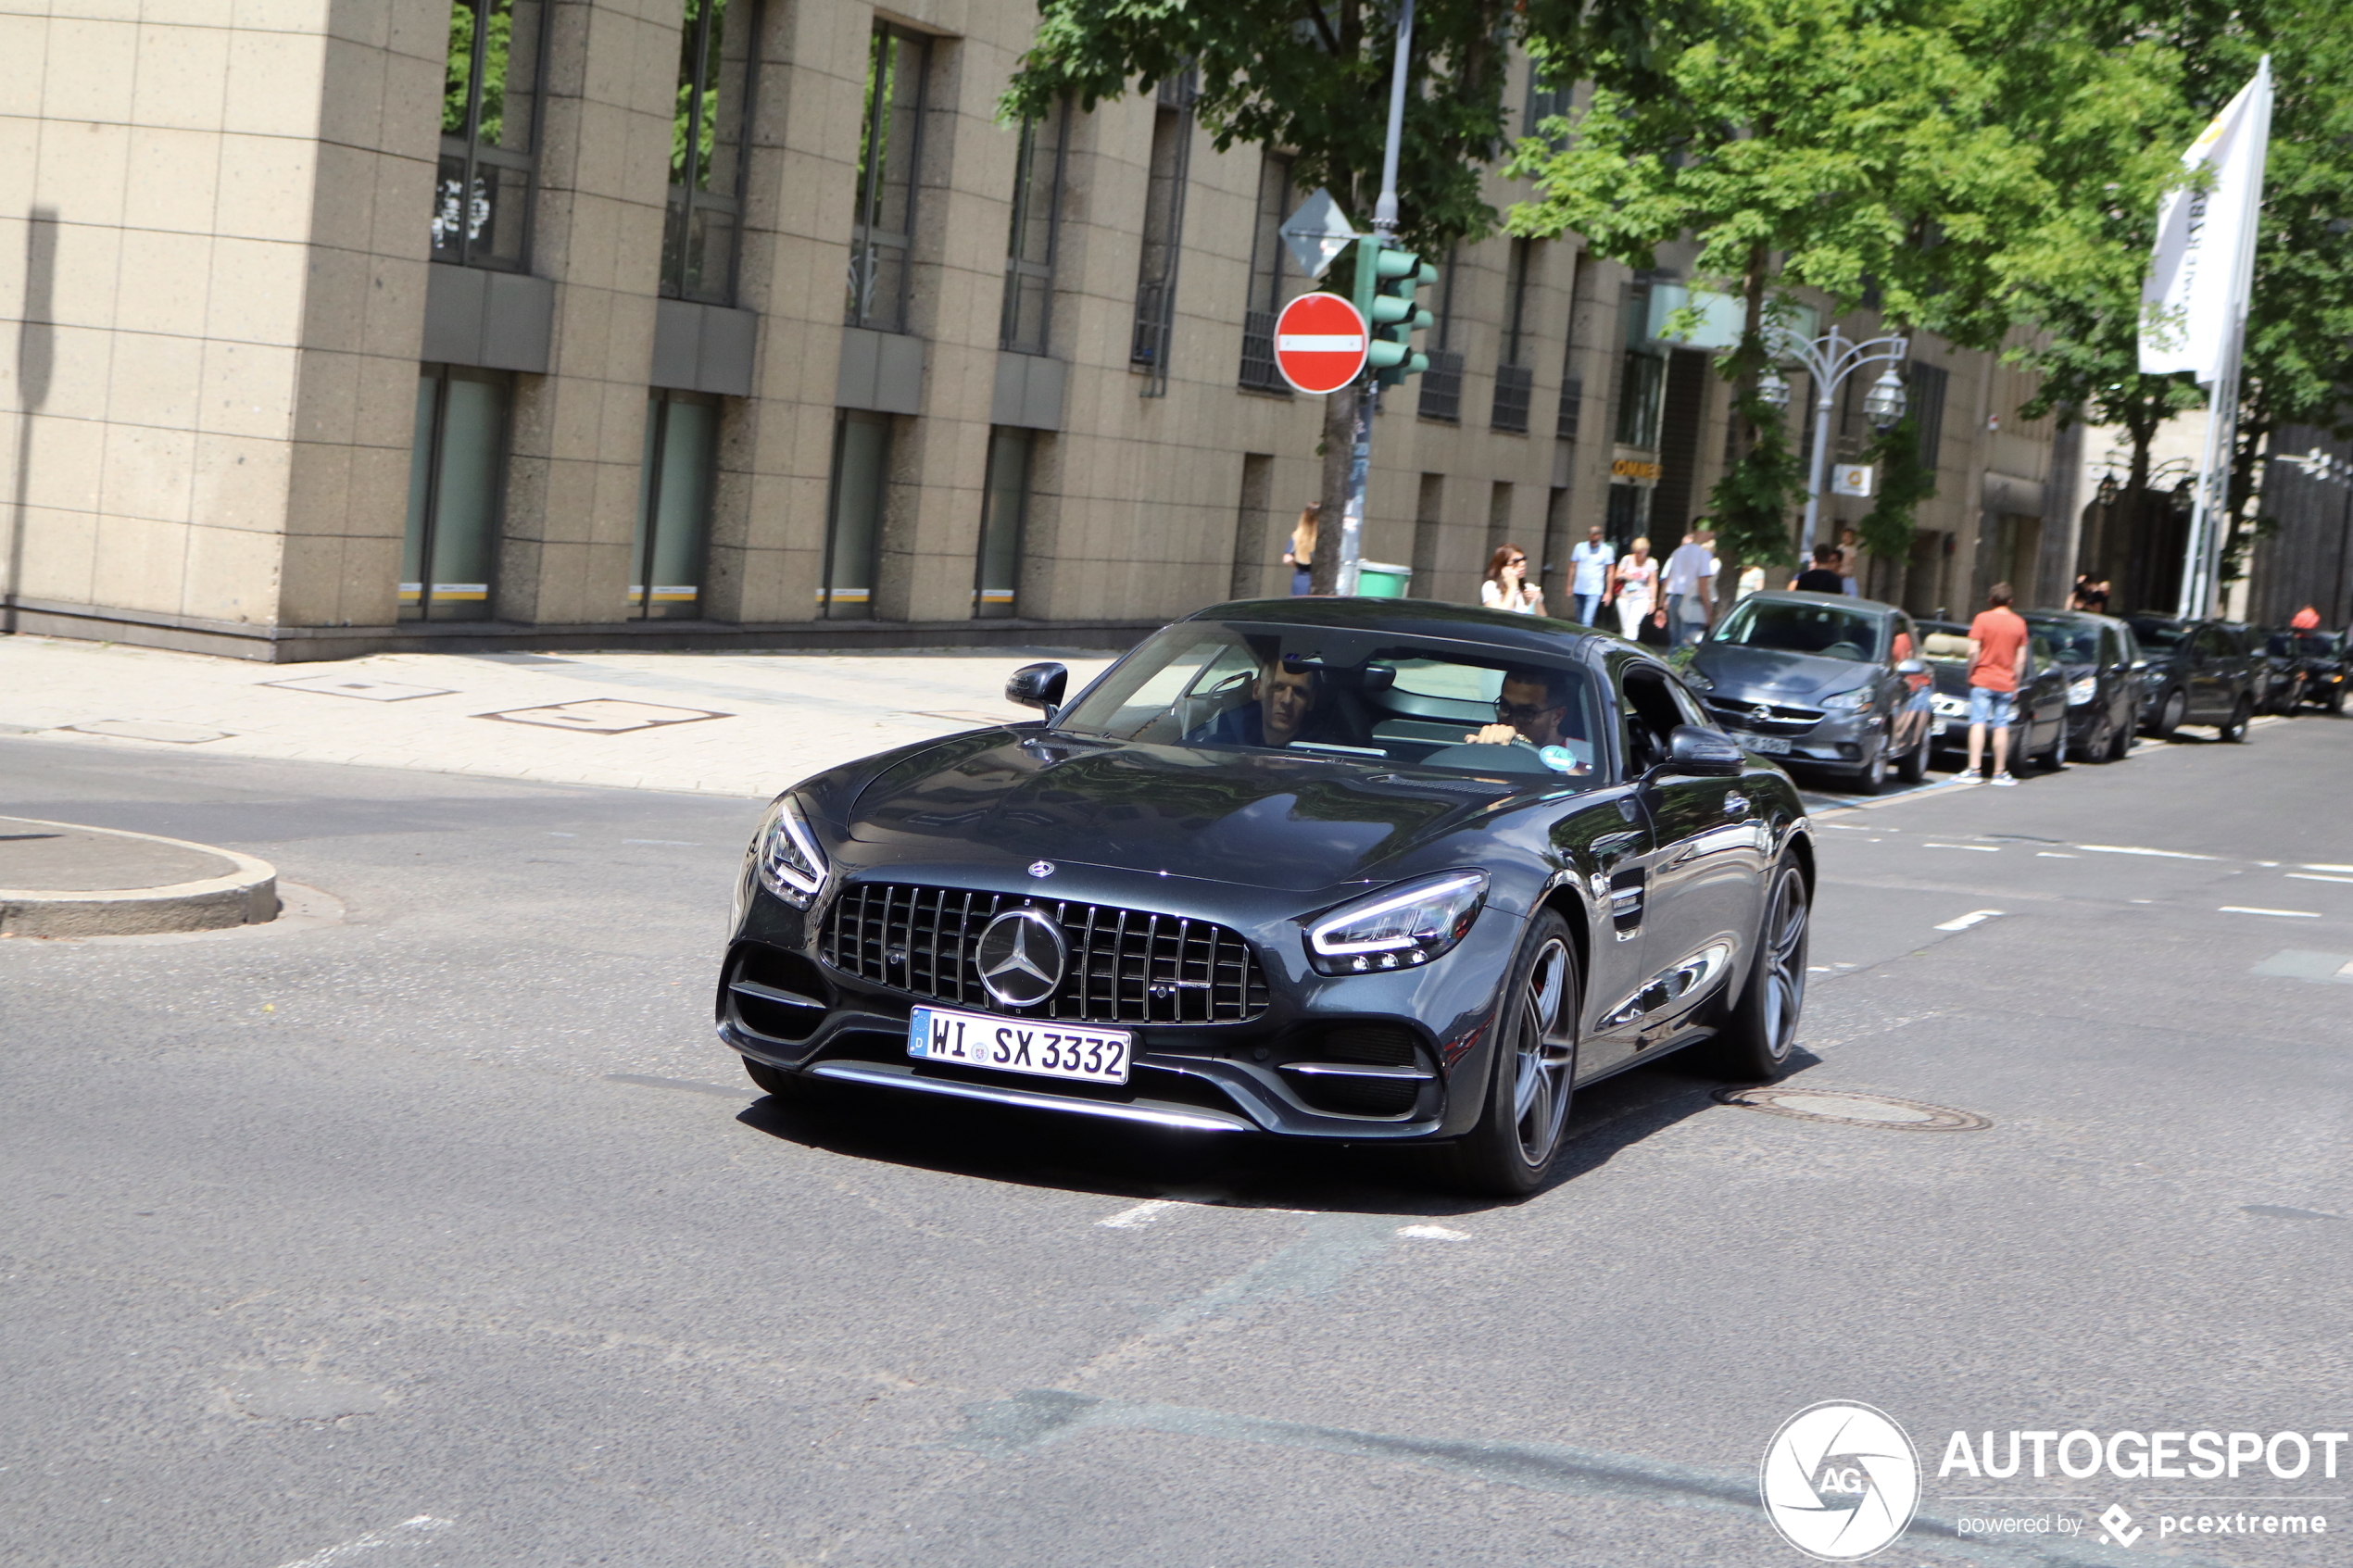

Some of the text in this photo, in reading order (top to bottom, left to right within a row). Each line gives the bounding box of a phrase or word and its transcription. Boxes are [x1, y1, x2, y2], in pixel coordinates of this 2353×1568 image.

[915, 1036, 924, 1048] D
[932, 1018, 1125, 1076] WI SX 3332
